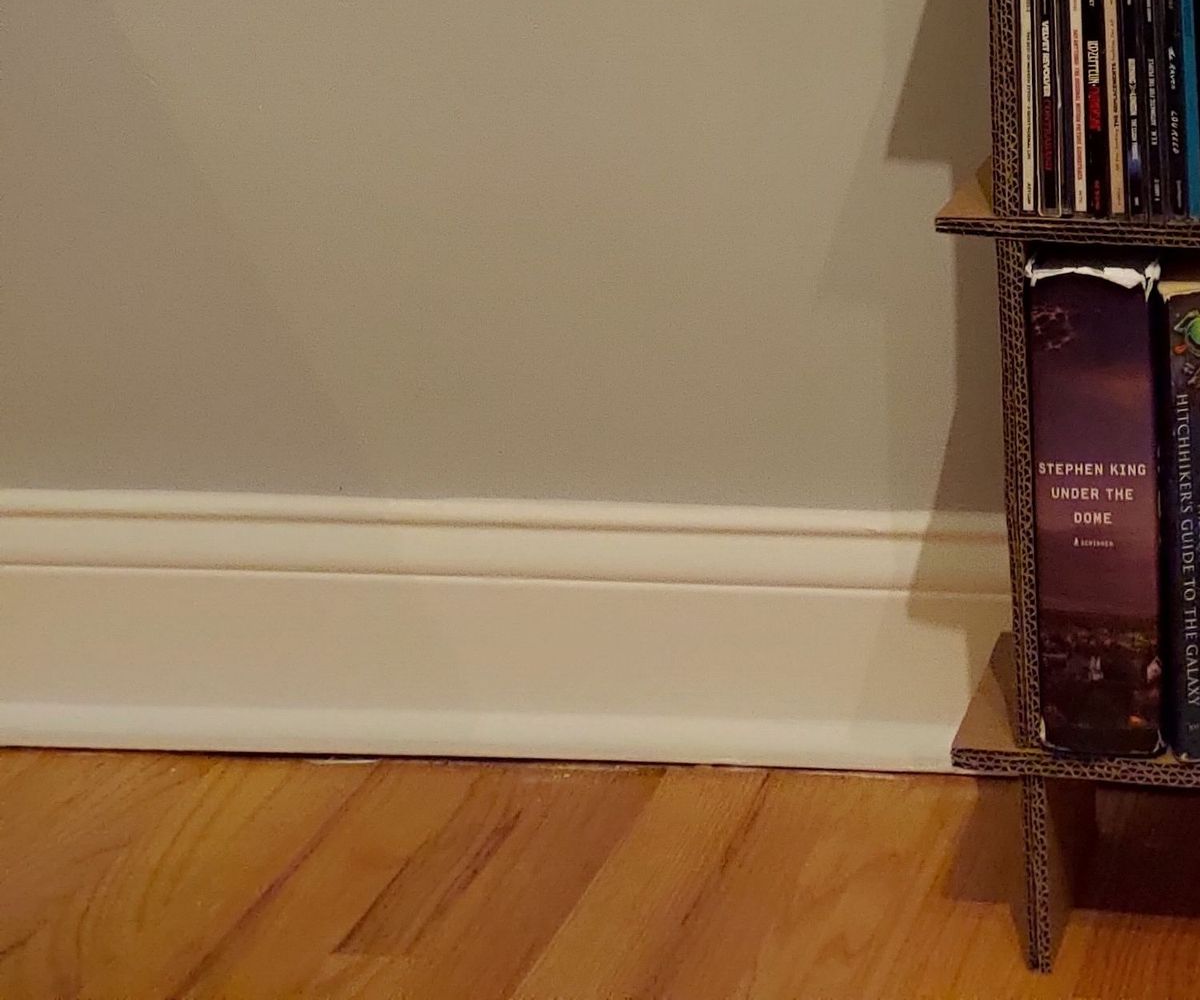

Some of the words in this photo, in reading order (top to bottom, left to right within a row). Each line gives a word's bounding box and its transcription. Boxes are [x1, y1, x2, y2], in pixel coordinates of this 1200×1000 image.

[1041, 20, 1050, 52] VELVET
[1042, 52, 1051, 97] REVOLVER
[1038, 462, 1104, 476] STEPHEN
[1110, 463, 1146, 476] KING
[1175, 393, 1193, 514] HITCHHIKER'S
[1050, 487, 1099, 501] UNDER
[1105, 488, 1134, 501] THE
[1073, 511, 1113, 525] DOME
[1180, 518, 1196, 575] GUIDE
[1183, 578, 1197, 601] TO
[1184, 606, 1198, 640] THE
[1186, 643, 1200, 706] GALAXY
